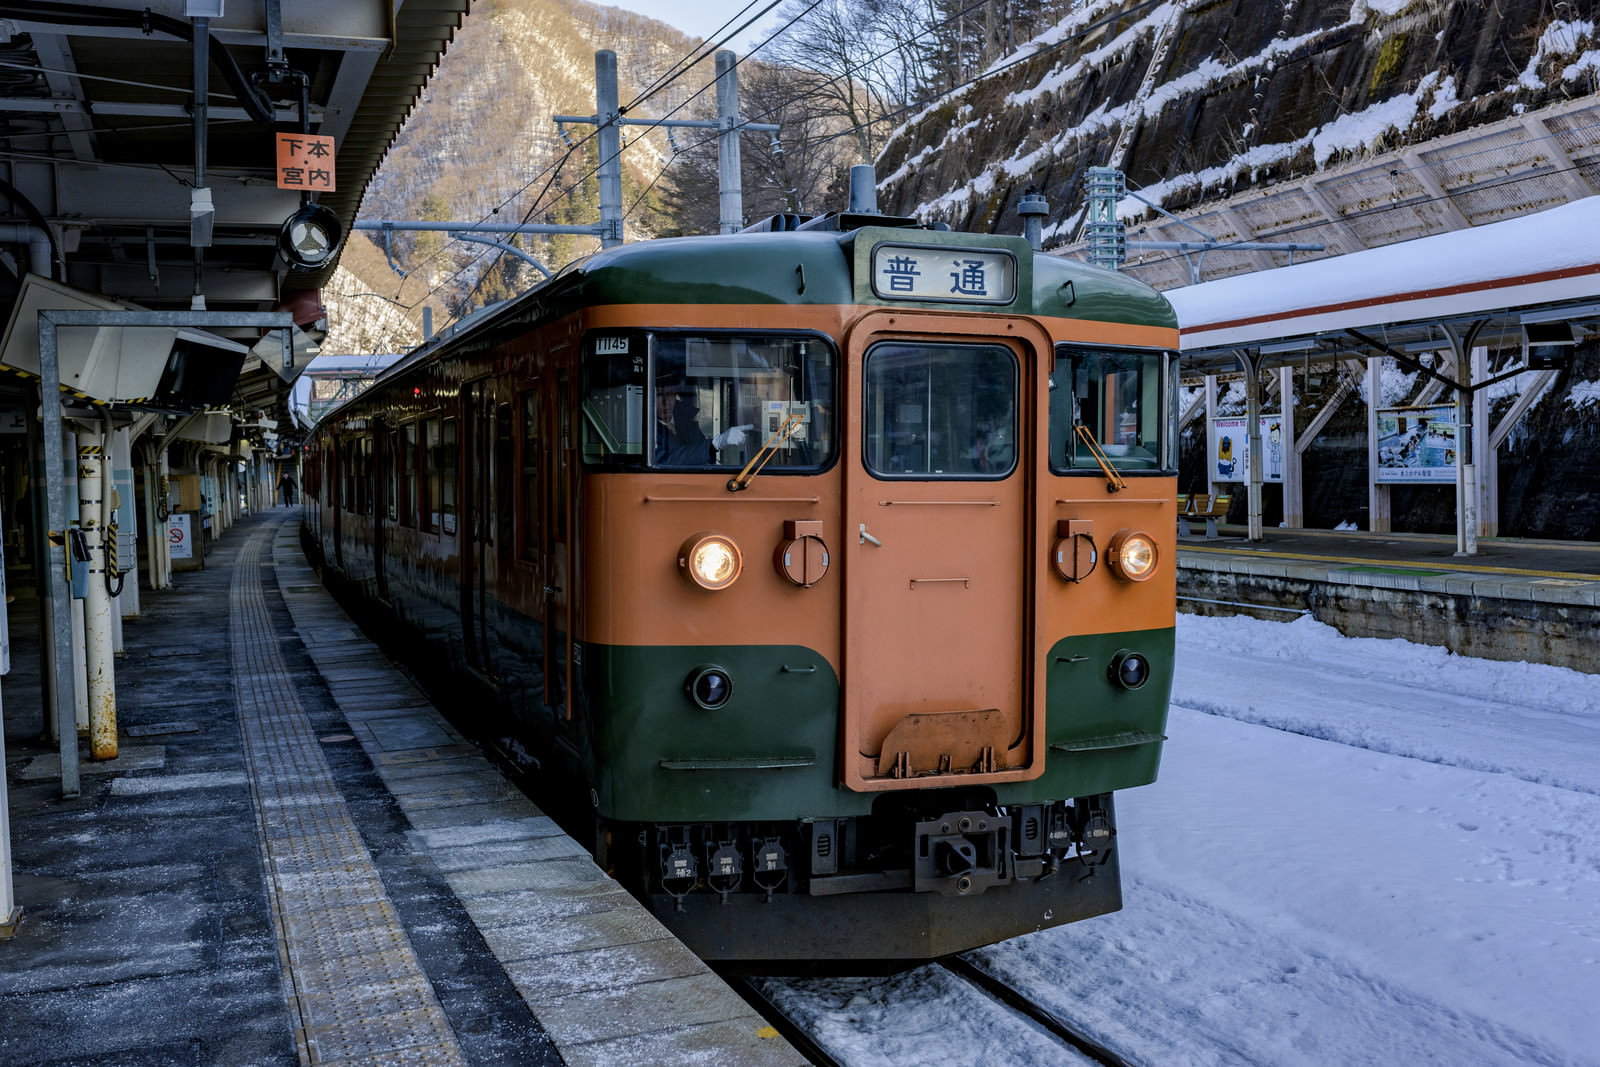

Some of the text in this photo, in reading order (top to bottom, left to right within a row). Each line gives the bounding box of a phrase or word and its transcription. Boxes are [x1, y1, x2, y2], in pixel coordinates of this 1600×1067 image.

[281, 166, 330, 186] 宮内
[883, 255, 987, 296] 普通
[1215, 420, 1239, 428] Welcome
